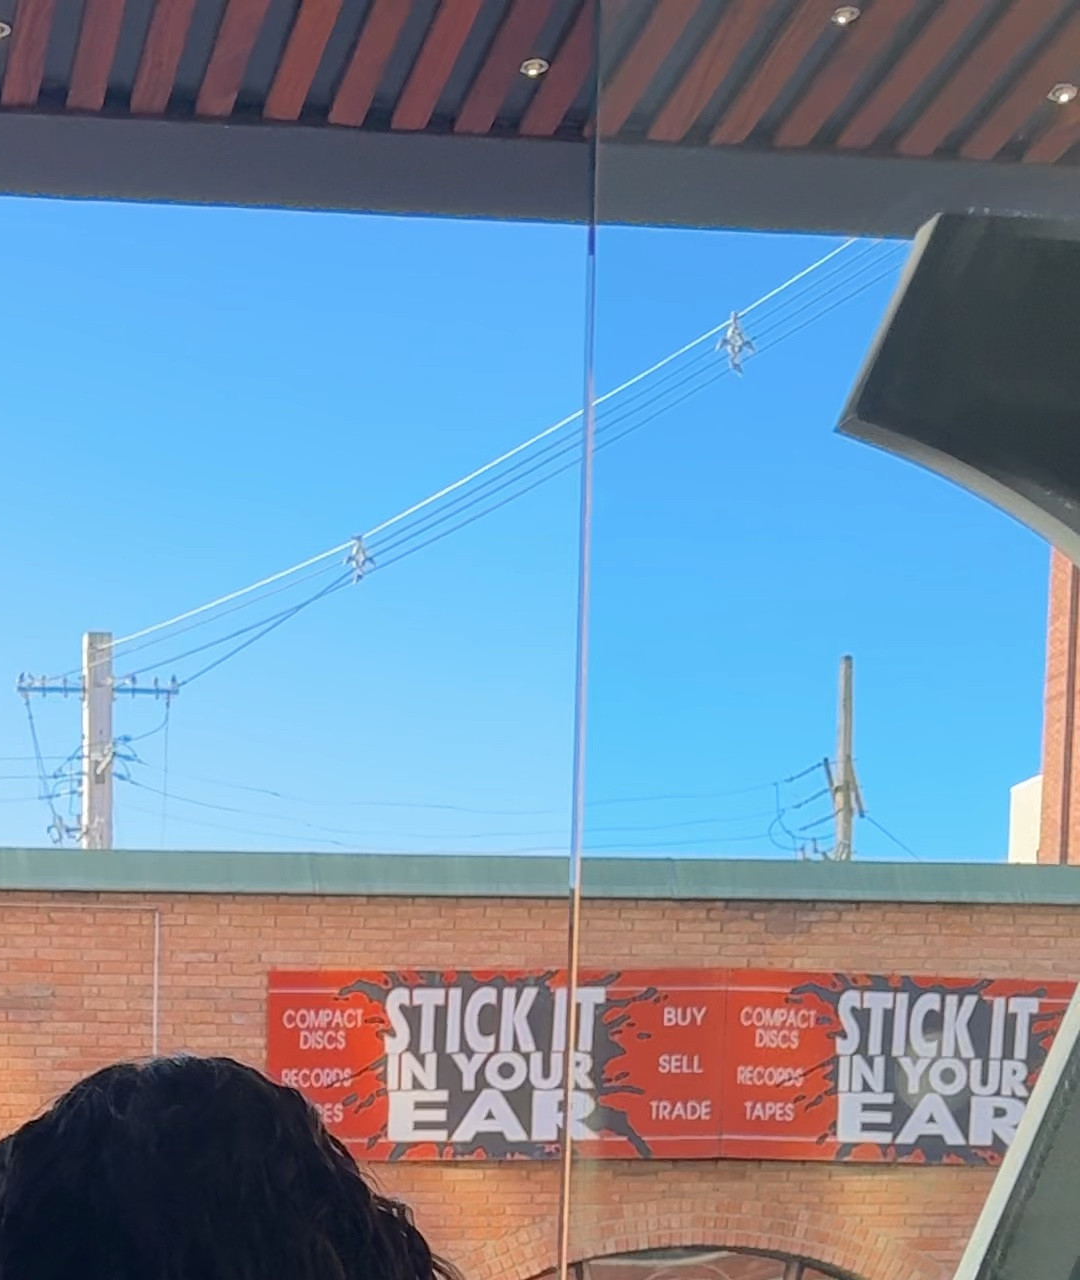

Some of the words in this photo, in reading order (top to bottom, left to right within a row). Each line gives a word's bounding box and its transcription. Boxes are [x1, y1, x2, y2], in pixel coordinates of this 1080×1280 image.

[283, 1009, 364, 1029] COMPACT
[384, 986, 540, 1055] STICK
[552, 986, 606, 1054] IT
[663, 1007, 706, 1027] BUY
[740, 1007, 816, 1029] COMPACT
[836, 989, 979, 1058] STICK
[989, 996, 1039, 1060] IT
[299, 1031, 347, 1051] DISCS
[755, 1028, 799, 1049] DISCS
[387, 1052, 437, 1091] IN
[451, 1052, 595, 1092] YOUR
[658, 1053, 704, 1074] SELL
[280, 1067, 353, 1089] RECORDS
[736, 1066, 804, 1087] RECORDS
[838, 1054, 886, 1093] IN
[897, 1057, 1029, 1097] YOUR
[387, 1088, 600, 1142] EAR
[650, 1100, 711, 1120] TRADE
[744, 1102, 795, 1121] TAPES
[837, 1092, 1028, 1146] EAR
